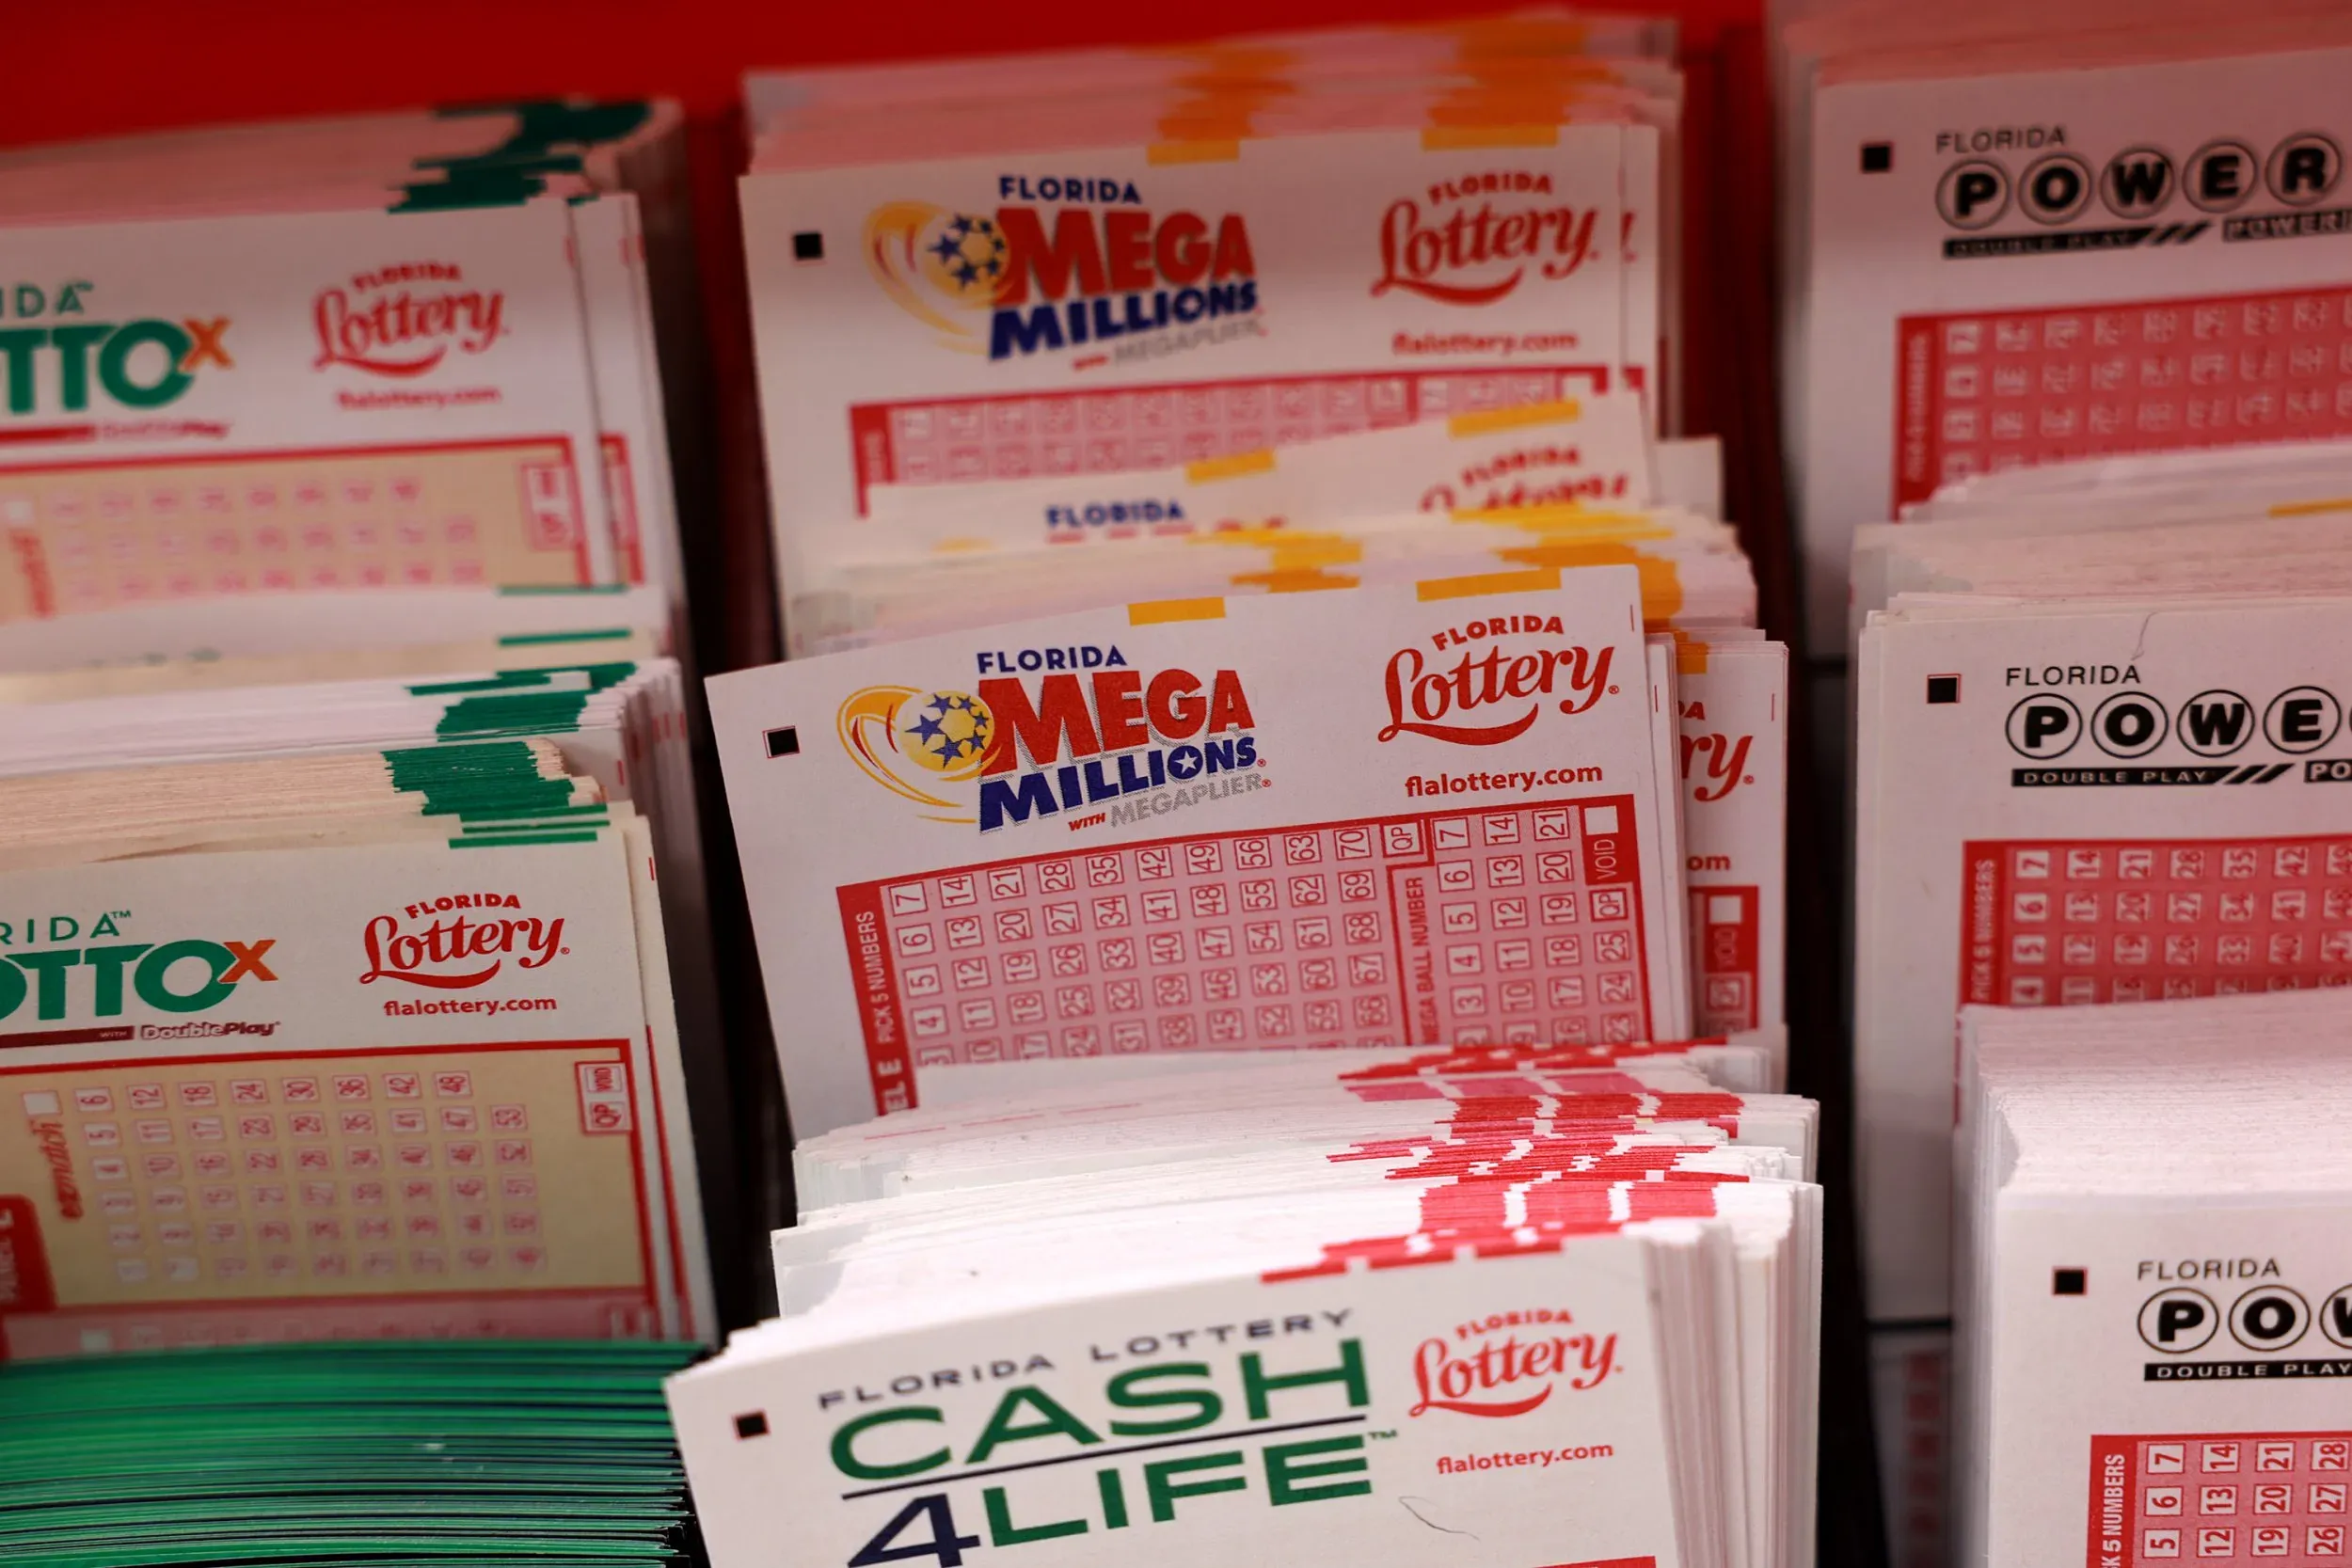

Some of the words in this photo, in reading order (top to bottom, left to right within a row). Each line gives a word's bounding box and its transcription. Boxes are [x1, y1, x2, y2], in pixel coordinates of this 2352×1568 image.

[1936, 127, 2066, 153] FLORIDA
[998, 174, 1142, 204] FLORIDA
[1427, 171, 1554, 206] FLORIDA
[994, 206, 1257, 309] MEGA
[1369, 198, 1598, 308] Lottery
[311, 287, 506, 378] Lottery
[990, 280, 1259, 363] MILLIONS
[1431, 615, 1564, 651] FLORIDA
[977, 644, 1127, 674] FLORIDA
[2006, 665, 2140, 687] FLORIDA
[1377, 644, 1615, 746] Lottery
[977, 669, 1256, 777] MEGA
[978, 736, 1258, 833] MILLIONS
[1405, 764, 1603, 798] flalottery.com
[2024, 770, 2126, 784] DOUBLE
[2142, 769, 2207, 783] PLAY
[1068, 812, 1106, 832] WITH
[1110, 772, 1263, 828] MEGAPLIER
[1439, 830, 1465, 842] 7
[1490, 817, 1515, 843] 14
[1539, 812, 1565, 837] 21
[1291, 835, 1315, 862] 63
[1340, 830, 1364, 857] 70
[1391, 827, 1412, 850] QP
[1142, 849, 1166, 877] 42
[1191, 846, 1216, 872] 49
[1241, 840, 1265, 866] 56
[1596, 839, 1616, 879] VOID
[2023, 859, 2045, 869] 7
[2125, 853, 2149, 877] 21
[1045, 863, 1069, 890] 28
[1093, 856, 1119, 883] 35
[1444, 870, 1469, 882] 6
[1494, 859, 1519, 884] 13
[1545, 855, 1569, 879] 20
[946, 876, 967, 903] 14
[995, 872, 1021, 897] 21
[1247, 882, 1272, 908] 55
[1296, 878, 1321, 904] 62
[1345, 873, 1370, 899] 69
[405, 893, 521, 919] FLORIDA
[895, 891, 921, 908] 7
[1099, 897, 1124, 925] 34
[1149, 895, 1172, 921] 41
[1197, 886, 1221, 914] 48
[1406, 877, 1428, 946] NUMBER
[1548, 897, 1572, 923] 19
[1599, 895, 1620, 915] QP
[1002, 911, 1025, 940] 20
[1051, 905, 1075, 931] 27
[1449, 913, 1473, 925] 5
[1500, 901, 1524, 925] 12
[902, 932, 928, 949] 6
[951, 918, 976, 944] 13
[1252, 923, 1277, 951] 54
[1301, 921, 1325, 945] 61
[1349, 914, 1375, 942] 68
[359, 915, 564, 990] Lottery
[855, 911, 888, 990] NUMBERS
[1105, 939, 1131, 967] 33
[1153, 935, 1178, 962] 40
[1202, 930, 1227, 957] 47
[1505, 945, 1526, 968] 11
[1551, 941, 1576, 965] 18
[1602, 933, 1626, 960] 25
[958, 959, 982, 986] 12
[1009, 954, 1032, 979] 19
[1057, 945, 1082, 974] 26
[1414, 952, 1434, 992] BALL
[1454, 955, 1477, 966] 4
[910, 974, 935, 990] 5
[1306, 960, 1330, 988] 60
[384, 998, 557, 1017] flalottery.com
[871, 992, 889, 1005] 5
[1014, 994, 1038, 1022] 18
[141, 1022, 276, 1040] DoublePlay
[917, 1017, 941, 1029] 4
[964, 1009, 989, 1029] 11
[2137, 1258, 2281, 1281] FLORIDA
[1455, 1308, 1573, 1339] FLORIDA
[818, 1354, 1056, 1409] FLORIDA
[1089, 1308, 1352, 1362] LOTTERY
[2156, 1364, 2267, 1379] DOUBLE
[1408, 1332, 1618, 1418] Lottery
[828, 1337, 1371, 1481] CASH
[1437, 1444, 1613, 1474] flalottery.com
[2154, 1452, 2181, 1465] 7
[2210, 1444, 2236, 1469] 14
[2264, 1445, 2290, 1469] 21
[2318, 1443, 2345, 1468] 28
[2102, 1454, 2125, 1536] NUMBERS
[2152, 1495, 2178, 1508] 6
[2206, 1488, 2233, 1512] 13
[2261, 1486, 2286, 1512] 20
[2315, 1486, 2343, 1511] 27
[2103, 1539, 2122, 1552] 5
[2151, 1537, 2176, 1550] 5
[2204, 1529, 2231, 1553] 12
[2258, 1528, 2284, 1552] 19
[2313, 1528, 2340, 1553] 26
